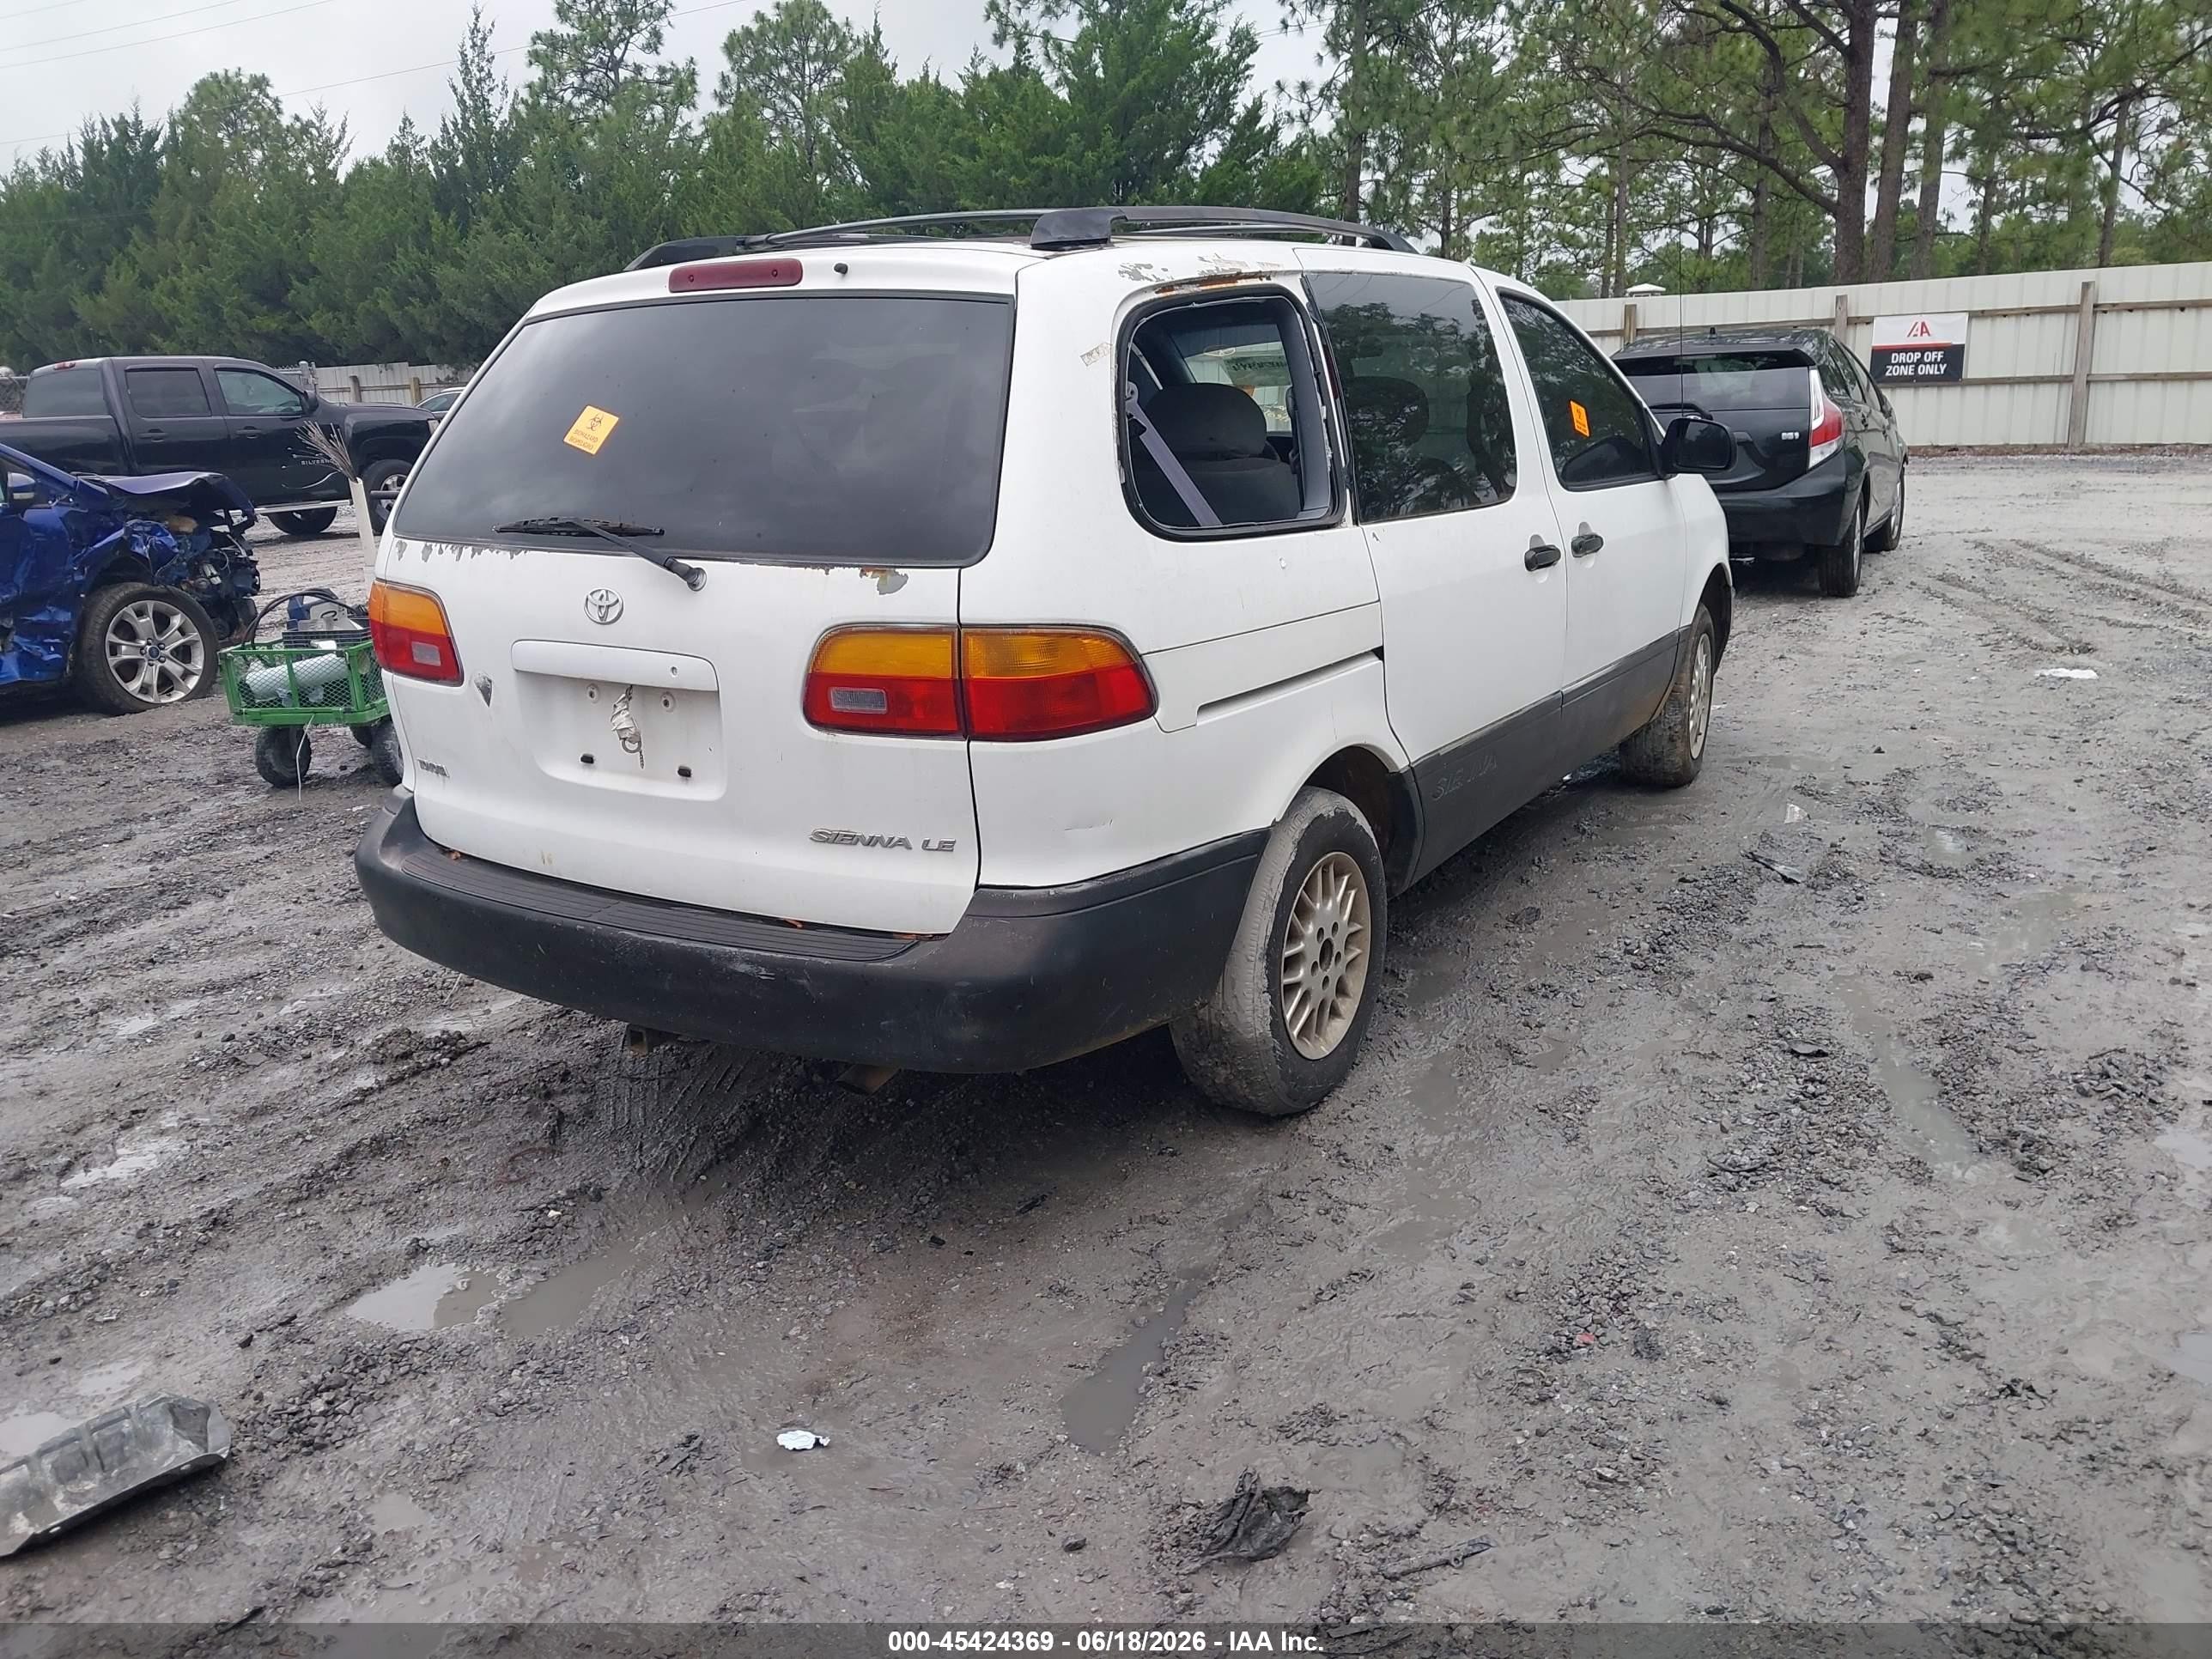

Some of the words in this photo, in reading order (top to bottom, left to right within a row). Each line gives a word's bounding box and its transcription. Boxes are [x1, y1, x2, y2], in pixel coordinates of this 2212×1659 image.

[1891, 351, 1921, 364] DROP
[1923, 350, 1944, 362] OFF
[1885, 364, 1915, 376] ZONE
[1917, 363, 1947, 375] ONLY
[809, 828, 913, 850] SIENNA
[921, 837, 957, 853] LE
